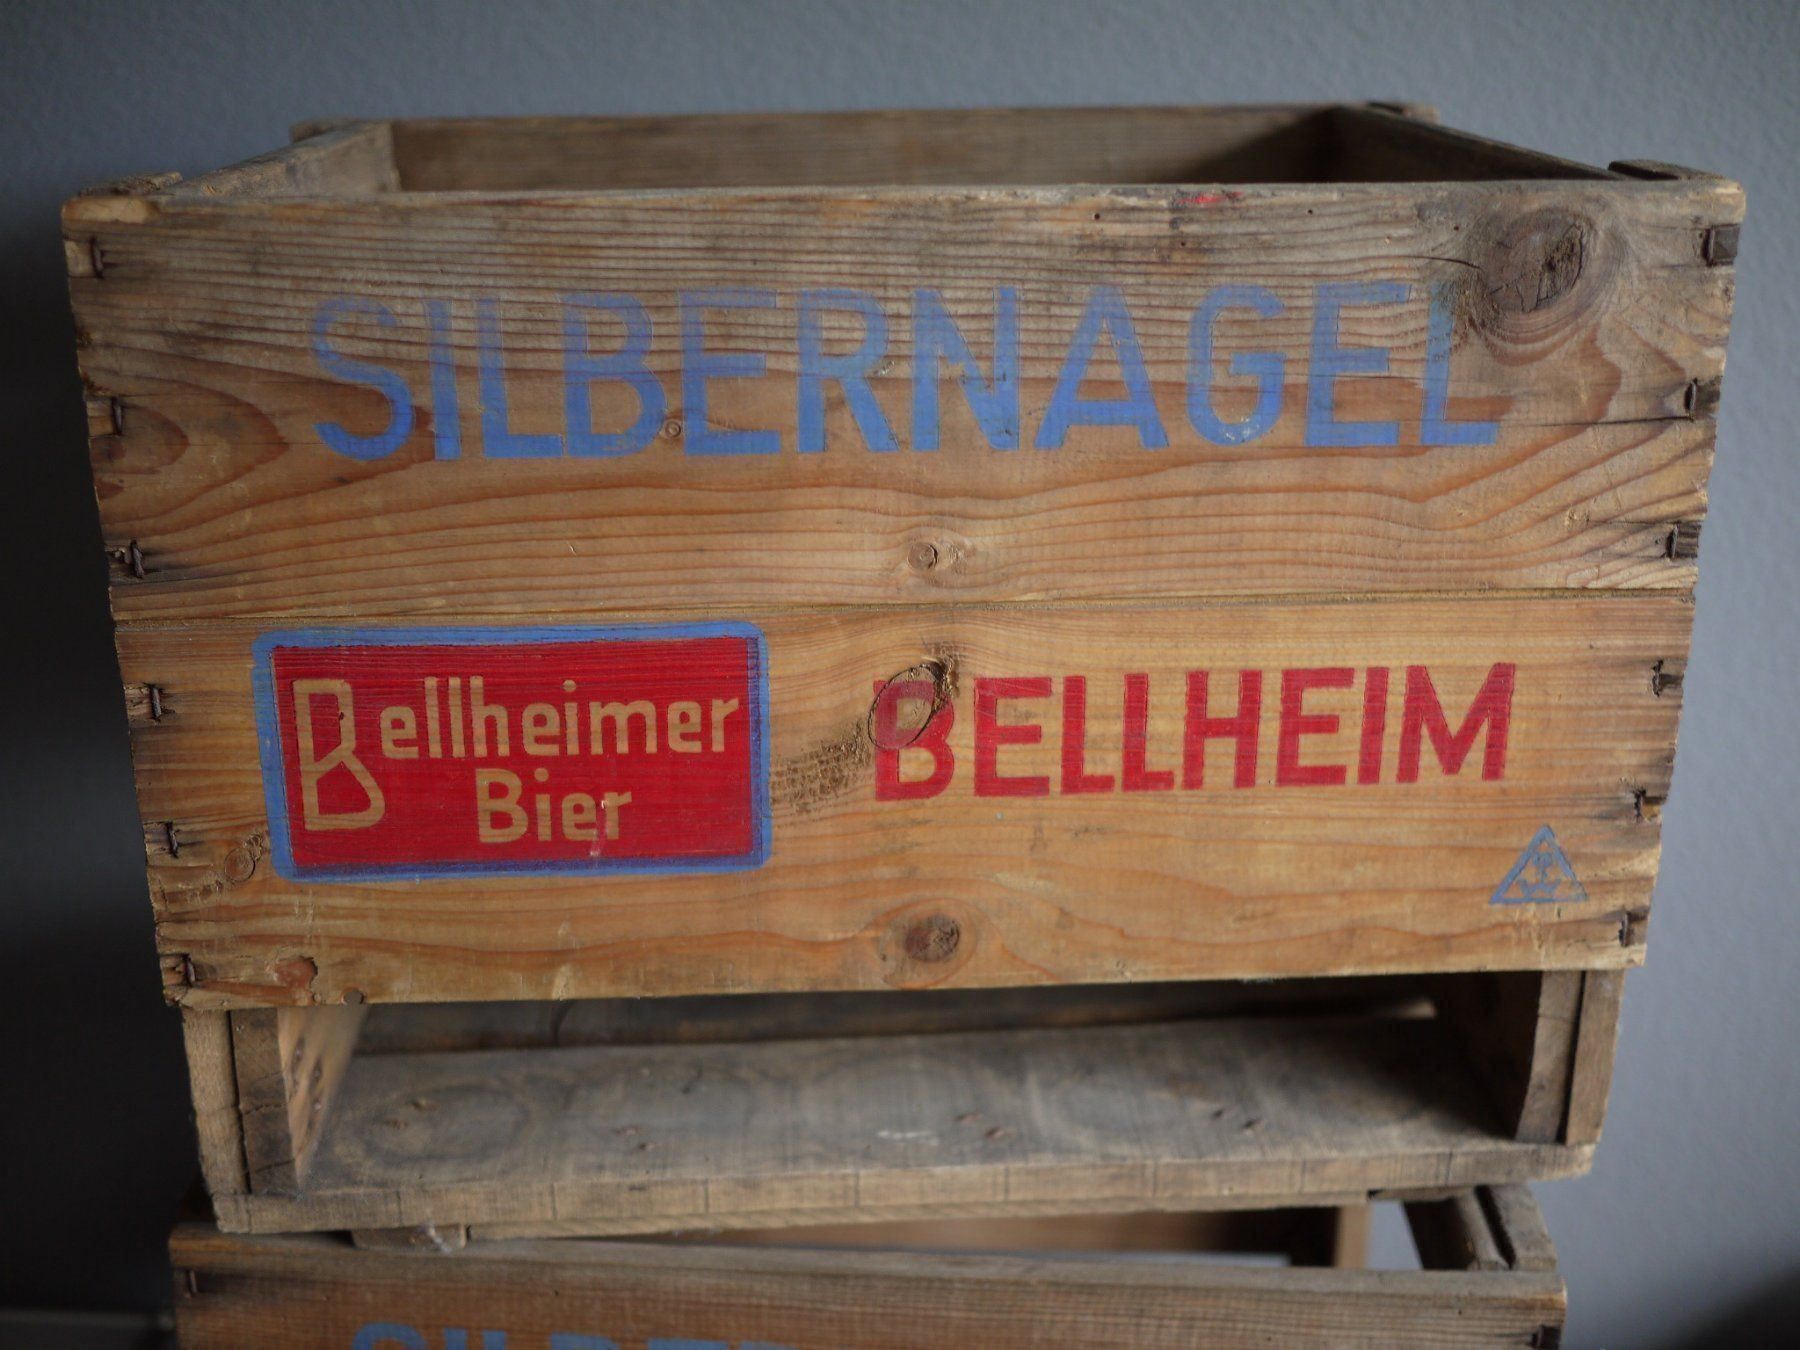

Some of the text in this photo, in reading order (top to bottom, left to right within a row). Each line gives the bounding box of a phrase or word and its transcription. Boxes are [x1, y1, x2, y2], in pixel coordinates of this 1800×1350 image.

[311, 284, 1498, 461] SILBERNAGEL
[293, 676, 740, 832] Bellheimer
[873, 662, 1516, 801] BELLHEIM
[476, 768, 632, 843] Bier
